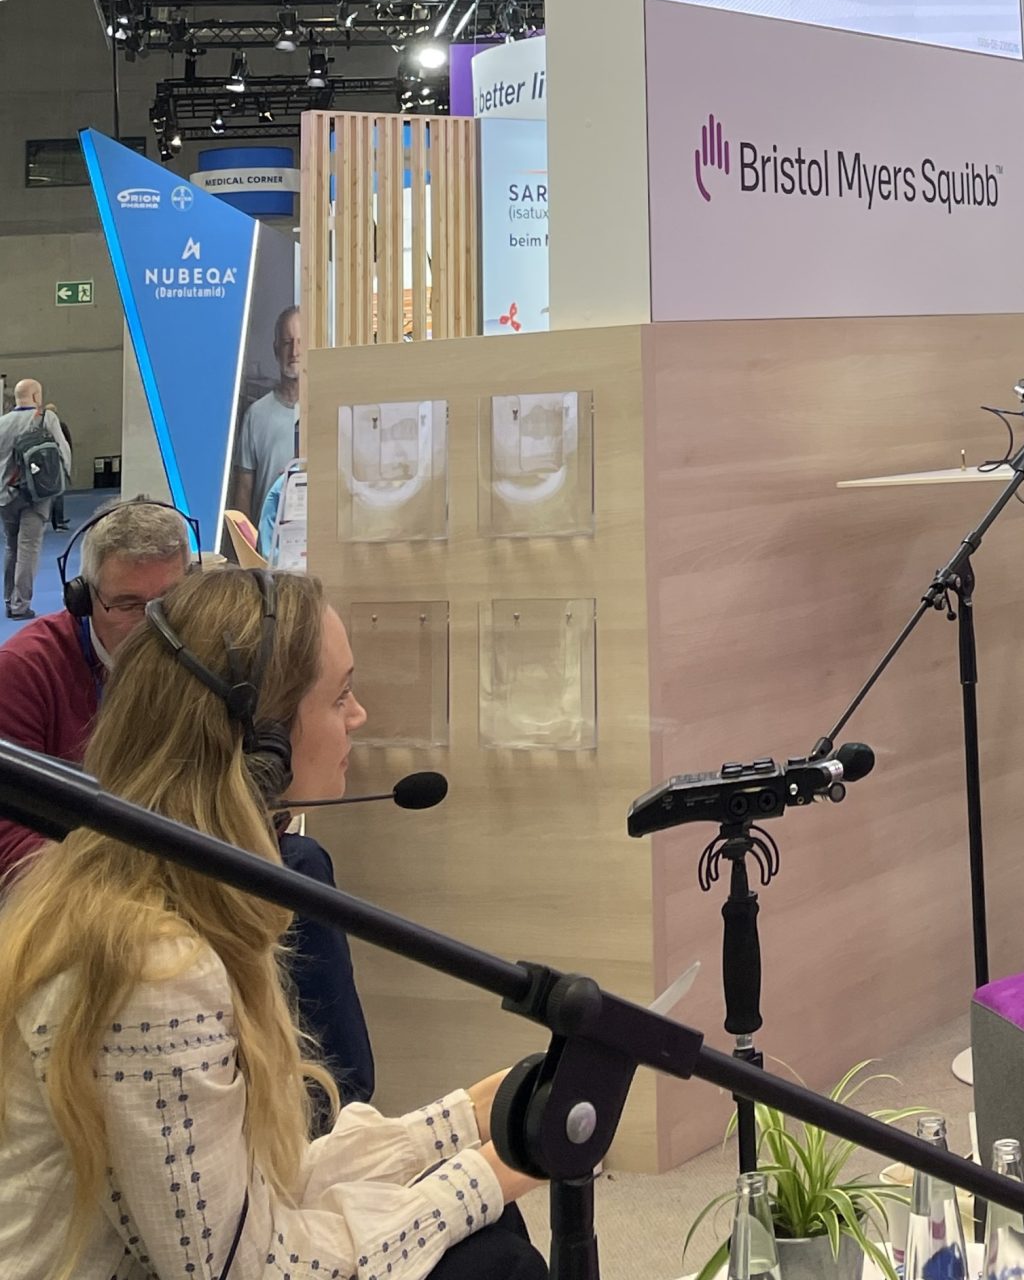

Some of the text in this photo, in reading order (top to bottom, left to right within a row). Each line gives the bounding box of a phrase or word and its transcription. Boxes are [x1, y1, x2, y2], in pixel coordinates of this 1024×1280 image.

[479, 79, 525, 113] better
[205, 176, 283, 187] MEDICAL CORNER
[740, 142, 829, 197] Bristol
[838, 151, 916, 210] Myers
[117, 188, 160, 203] ORION
[509, 234, 542, 247] beim
[155, 287, 225, 299] (Darolutamid)
